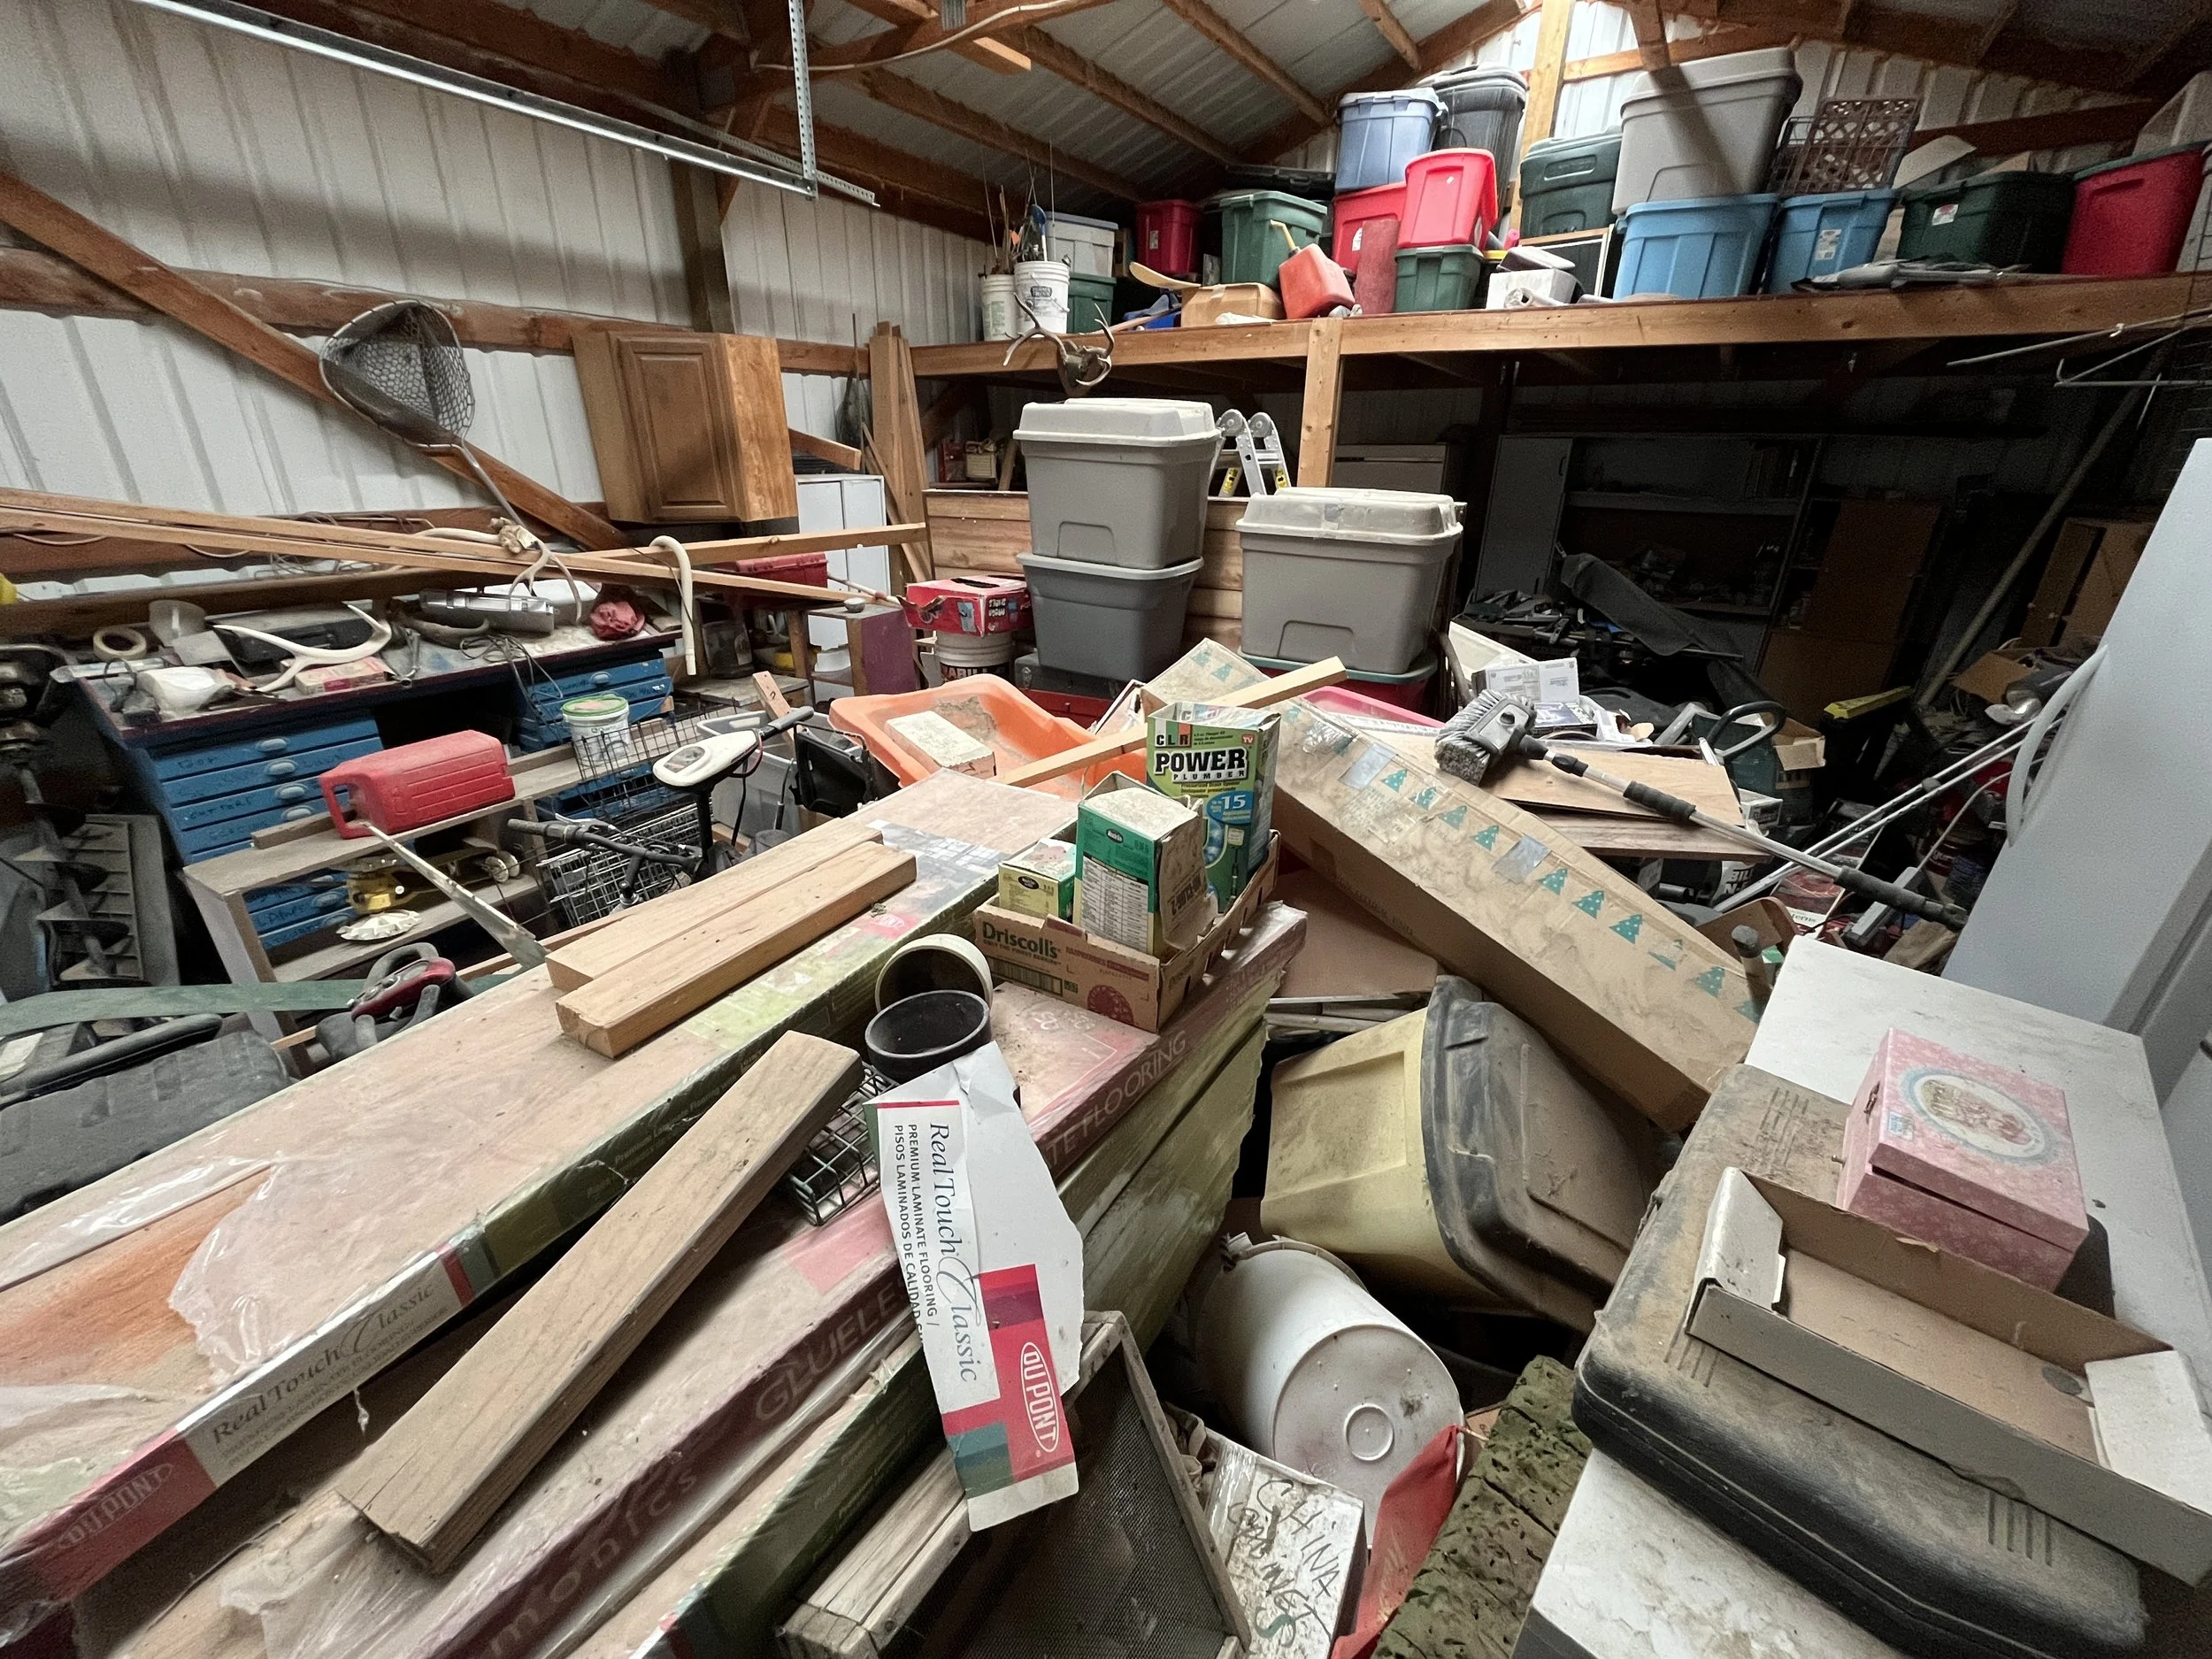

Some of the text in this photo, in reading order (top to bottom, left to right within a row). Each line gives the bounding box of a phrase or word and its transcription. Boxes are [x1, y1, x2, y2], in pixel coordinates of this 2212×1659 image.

[1155, 748, 1247, 772] POWER
[1156, 733, 1191, 747] CLR
[1173, 771, 1245, 780] PLUMBER
[1222, 795, 1246, 810] 15
[982, 921, 1058, 959] Driscoll's
[1080, 1029, 1187, 1139] FLOORING
[894, 1125, 904, 1161] PISOS
[908, 1123, 920, 1183] PREMIUM
[896, 1164, 910, 1240] LAMINADOS
[911, 1186, 926, 1248] LAMINATE
[902, 1242, 913, 1260] DE
[918, 1252, 937, 1317] FLOORING
[936, 1256, 980, 1383] Classic
[755, 1276, 904, 1419] GLUELE
